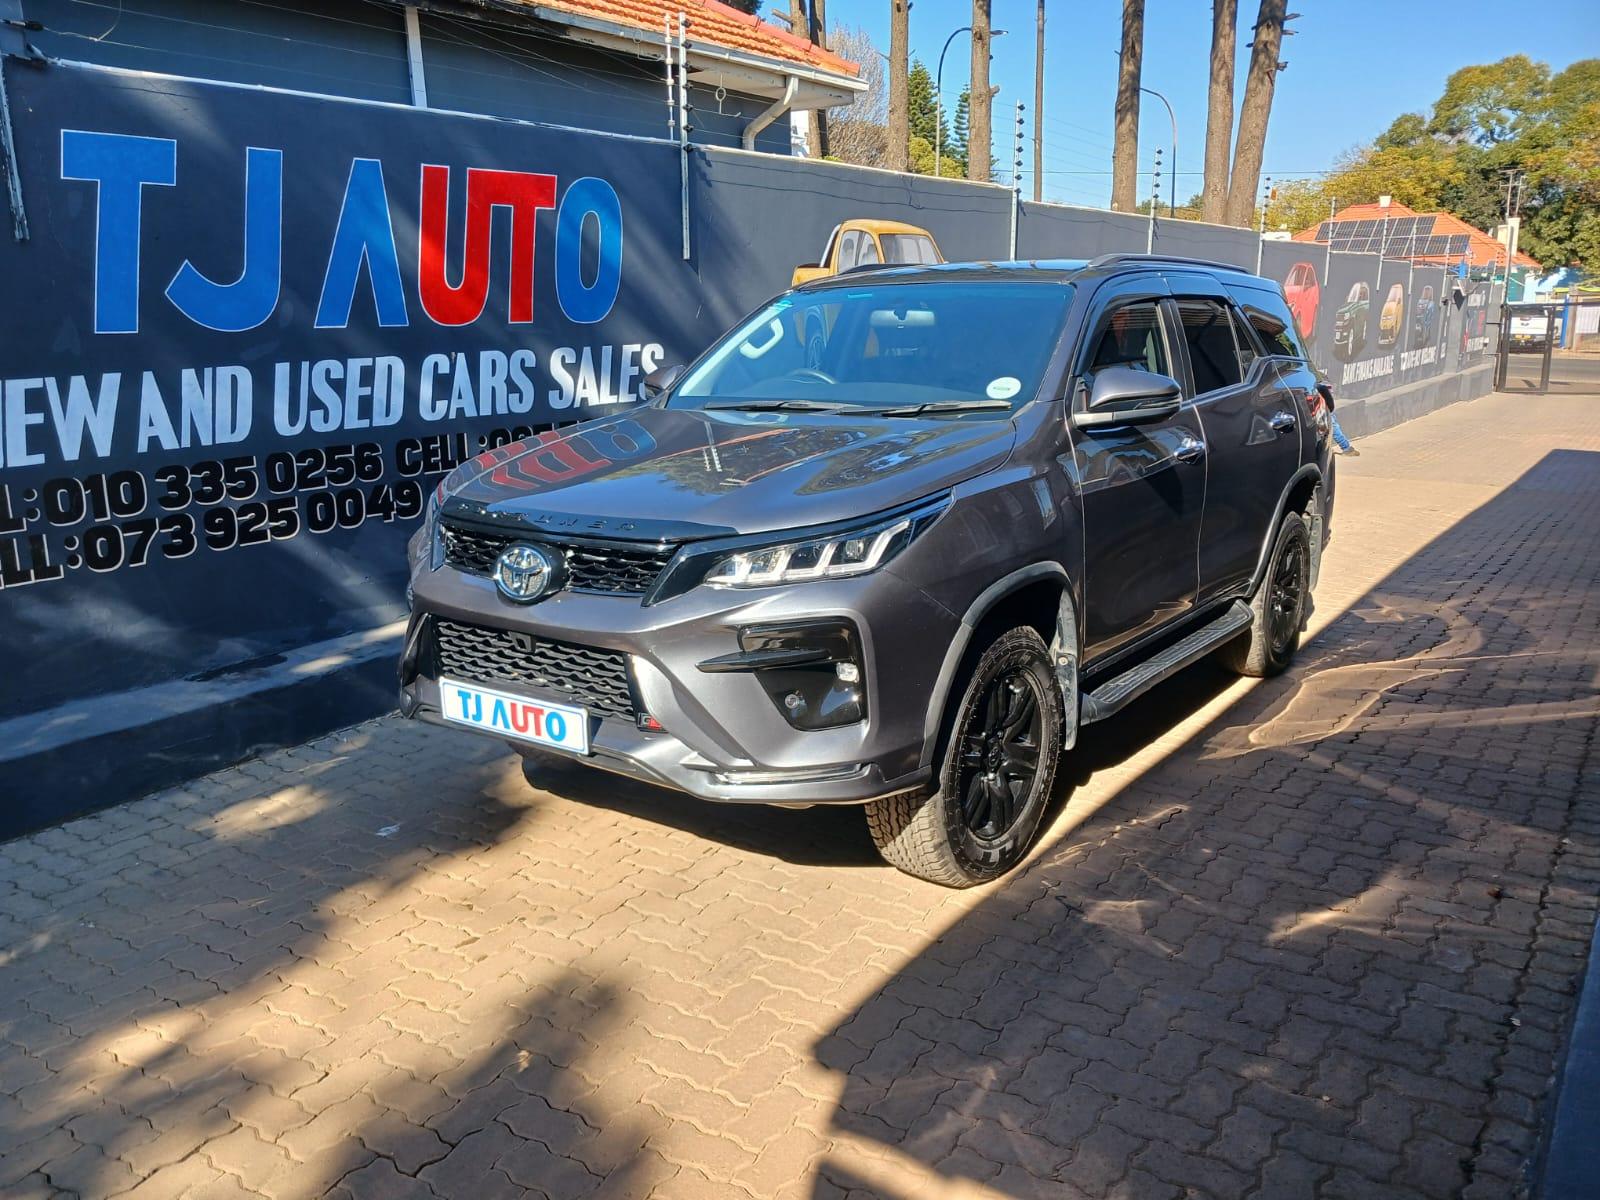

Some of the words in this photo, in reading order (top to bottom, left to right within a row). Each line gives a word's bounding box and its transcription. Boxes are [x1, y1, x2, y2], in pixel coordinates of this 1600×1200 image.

[60, 129, 283, 334] TJ
[313, 158, 623, 327] AUTO
[0, 372, 122, 469] EW
[137, 365, 253, 453] AND
[273, 355, 405, 437] USED
[419, 349, 536, 421] CARS
[549, 343, 664, 409] SALES
[155, 456, 259, 511] 335
[265, 442, 384, 495] 0256
[204, 496, 300, 551] 925
[306, 480, 423, 534] 0049
[457, 689, 482, 722] TJ
[492, 699, 567, 742] AUTO
